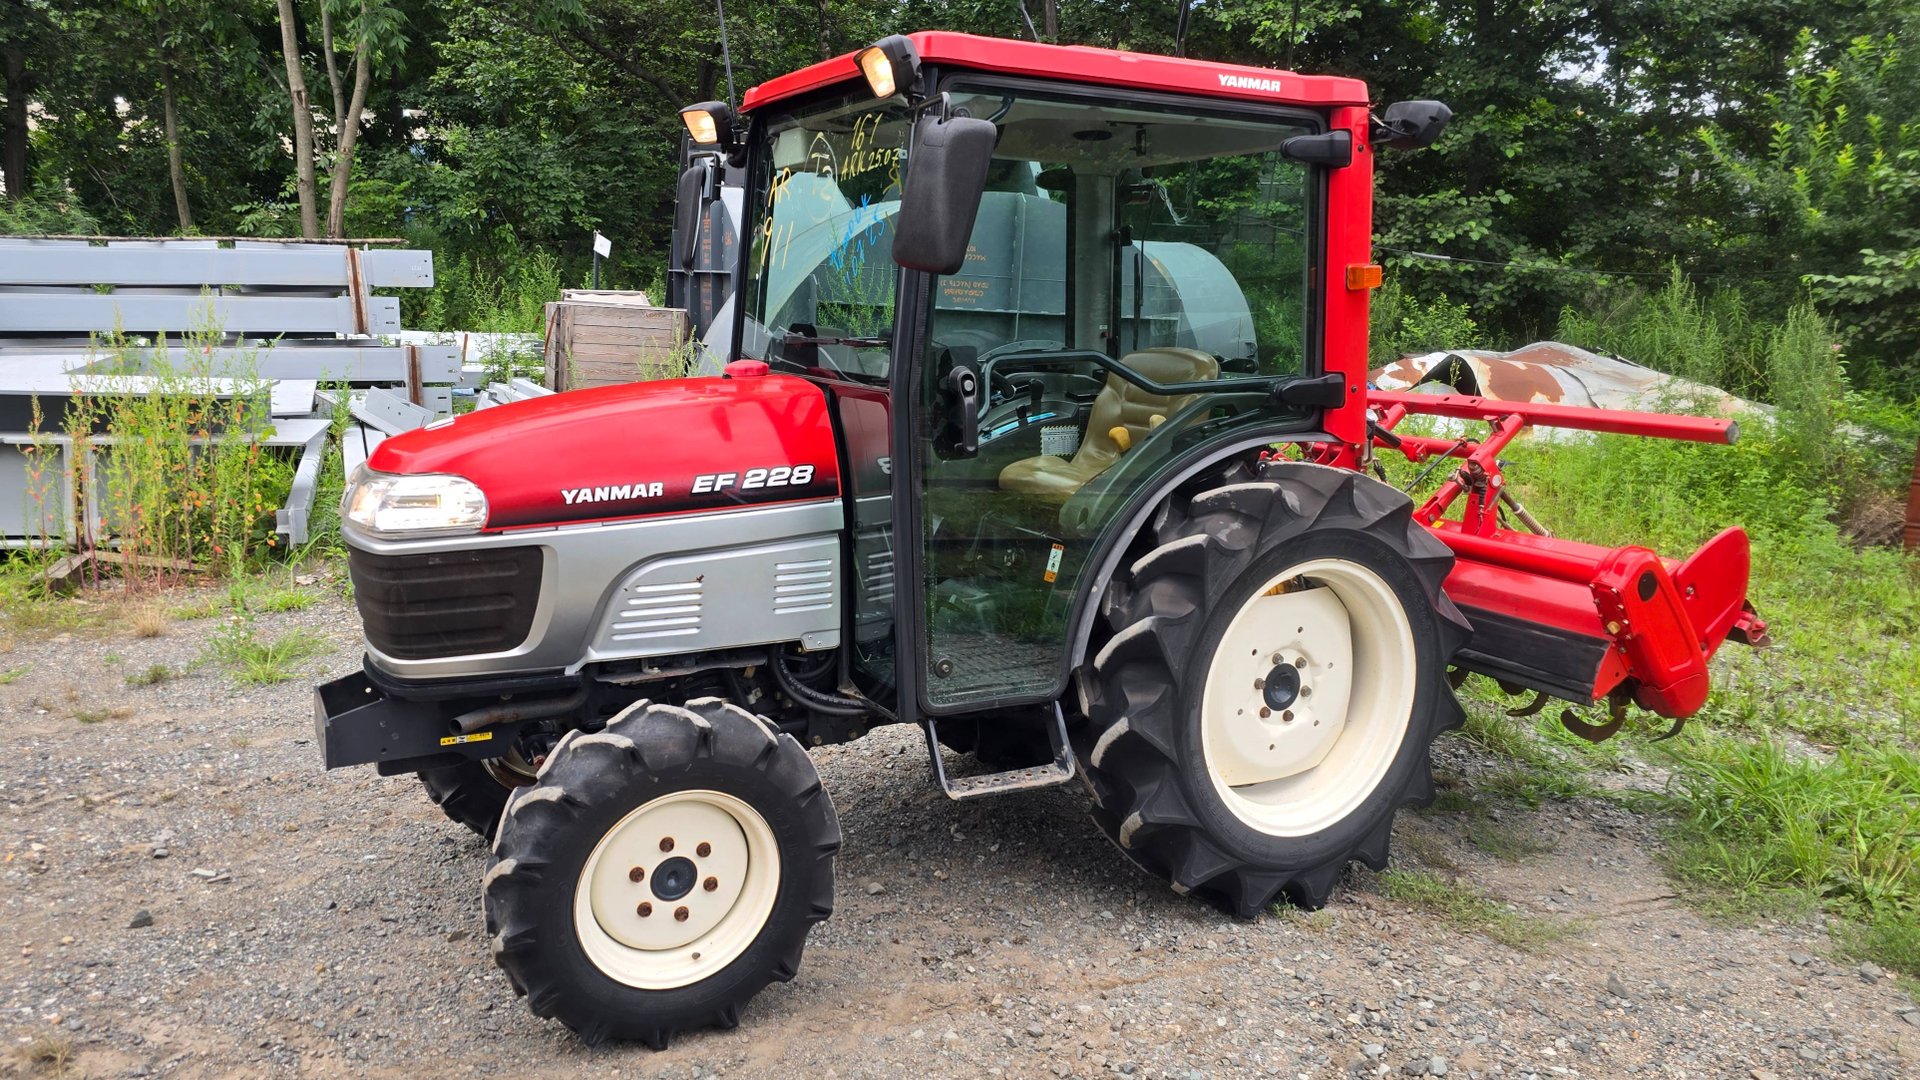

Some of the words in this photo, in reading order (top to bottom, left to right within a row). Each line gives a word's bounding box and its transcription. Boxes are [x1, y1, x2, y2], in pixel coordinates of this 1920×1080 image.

[1218, 74, 1281, 93] YANMAR
[691, 473, 736, 495] EF
[742, 465, 814, 490] 228
[561, 482, 663, 505] YANMAR
